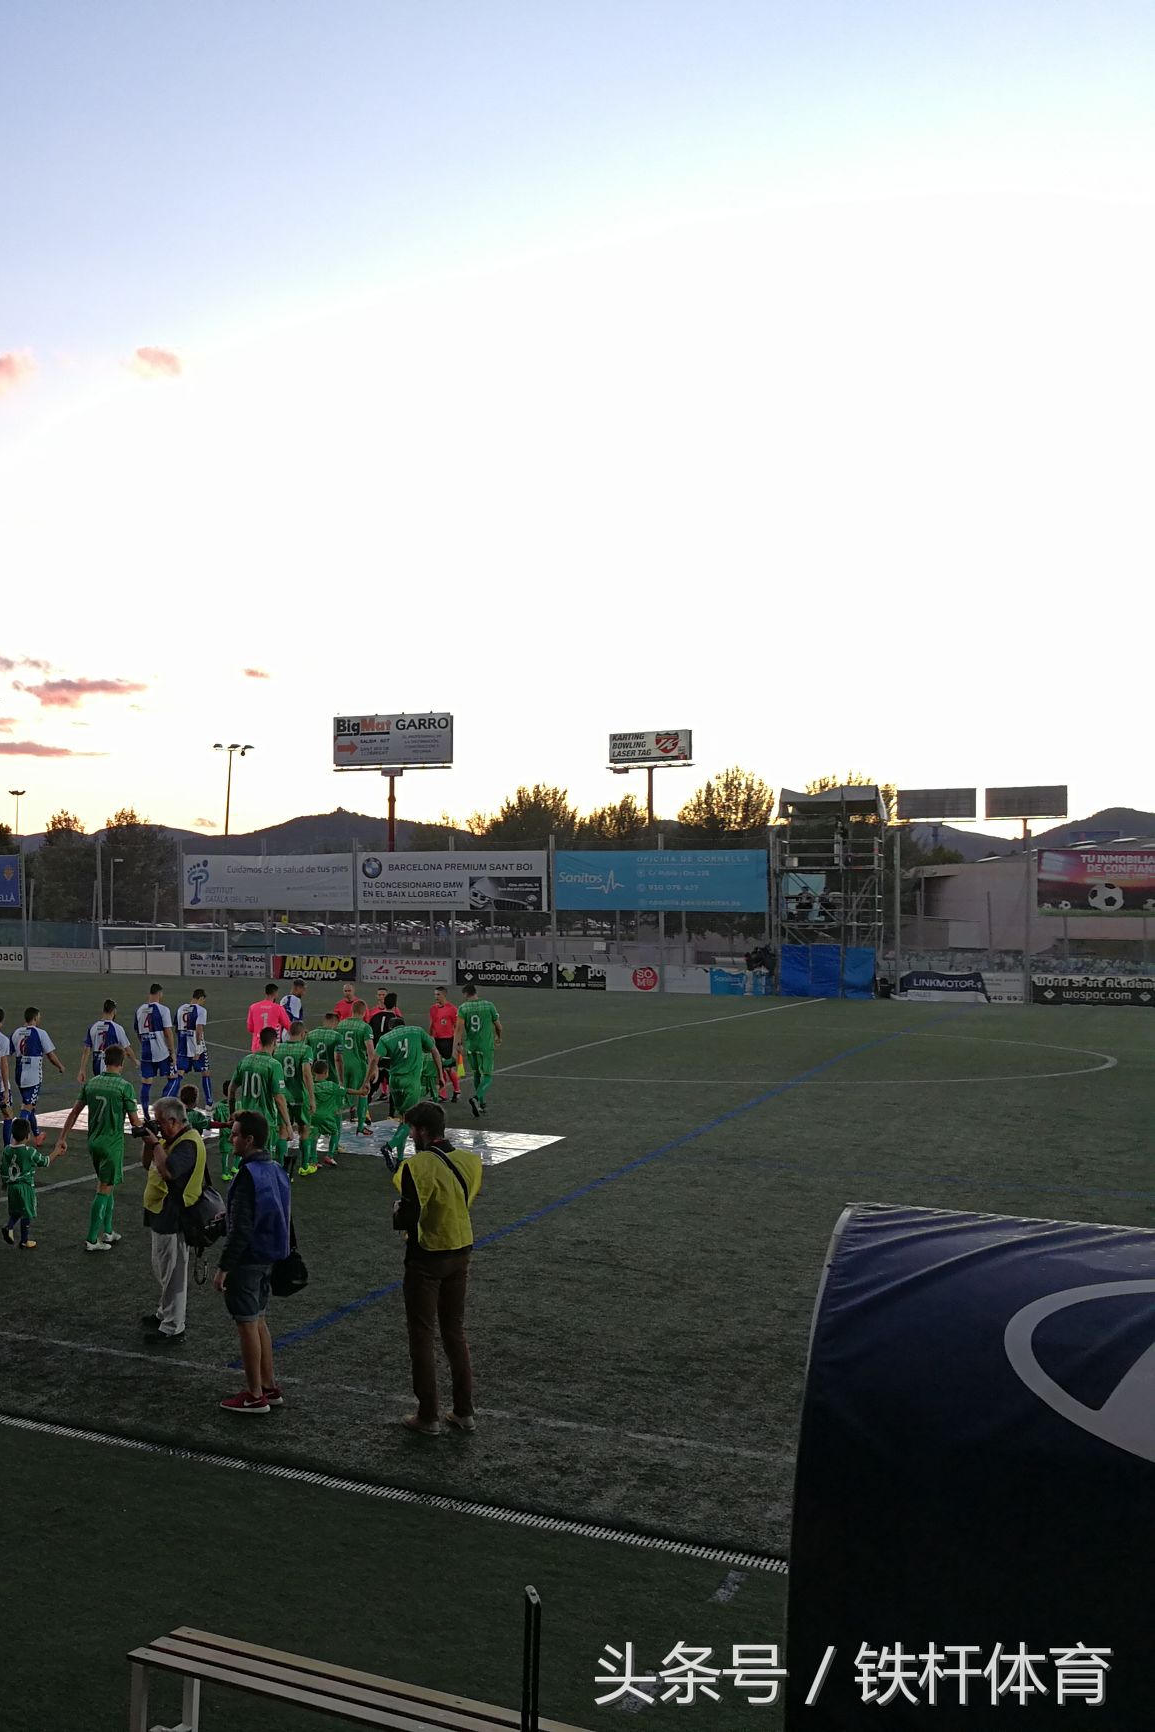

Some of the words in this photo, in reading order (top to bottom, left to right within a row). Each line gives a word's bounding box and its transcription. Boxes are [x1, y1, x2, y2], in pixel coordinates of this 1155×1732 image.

[337, 718, 391, 735] BigMat
[395, 717, 449, 731] GARRO
[612, 733, 645, 741] KARTING
[612, 741, 646, 749] BOWLING
[1080, 855, 1095, 863] TU
[226, 865, 262, 874] Cuidamos
[305, 865, 315, 873] de
[332, 864, 349, 875] pies
[388, 863, 443, 871] BARCELONA
[445, 863, 487, 871] PREMIUM
[489, 863, 513, 871] SANT
[516, 863, 533, 871] BOI
[1086, 864, 1102, 873] DE
[557, 872, 603, 884] Sanitas
[408, 890, 456, 898] LLOBREGAT
[284, 956, 355, 973] MUNDO
[382, 959, 447, 967] RESTAURANTE
[283, 970, 337, 979] DEPORTIVO
[372, 965, 390, 974] La
[470, 1014, 480, 1032] 9
[344, 1031, 354, 1050] 5
[316, 1042, 327, 1062] 2
[398, 1038, 409, 1059] 4
[283, 1056, 295, 1078] 8
[242, 1071, 262, 1099] 10
[95, 1096, 107, 1122] 7
